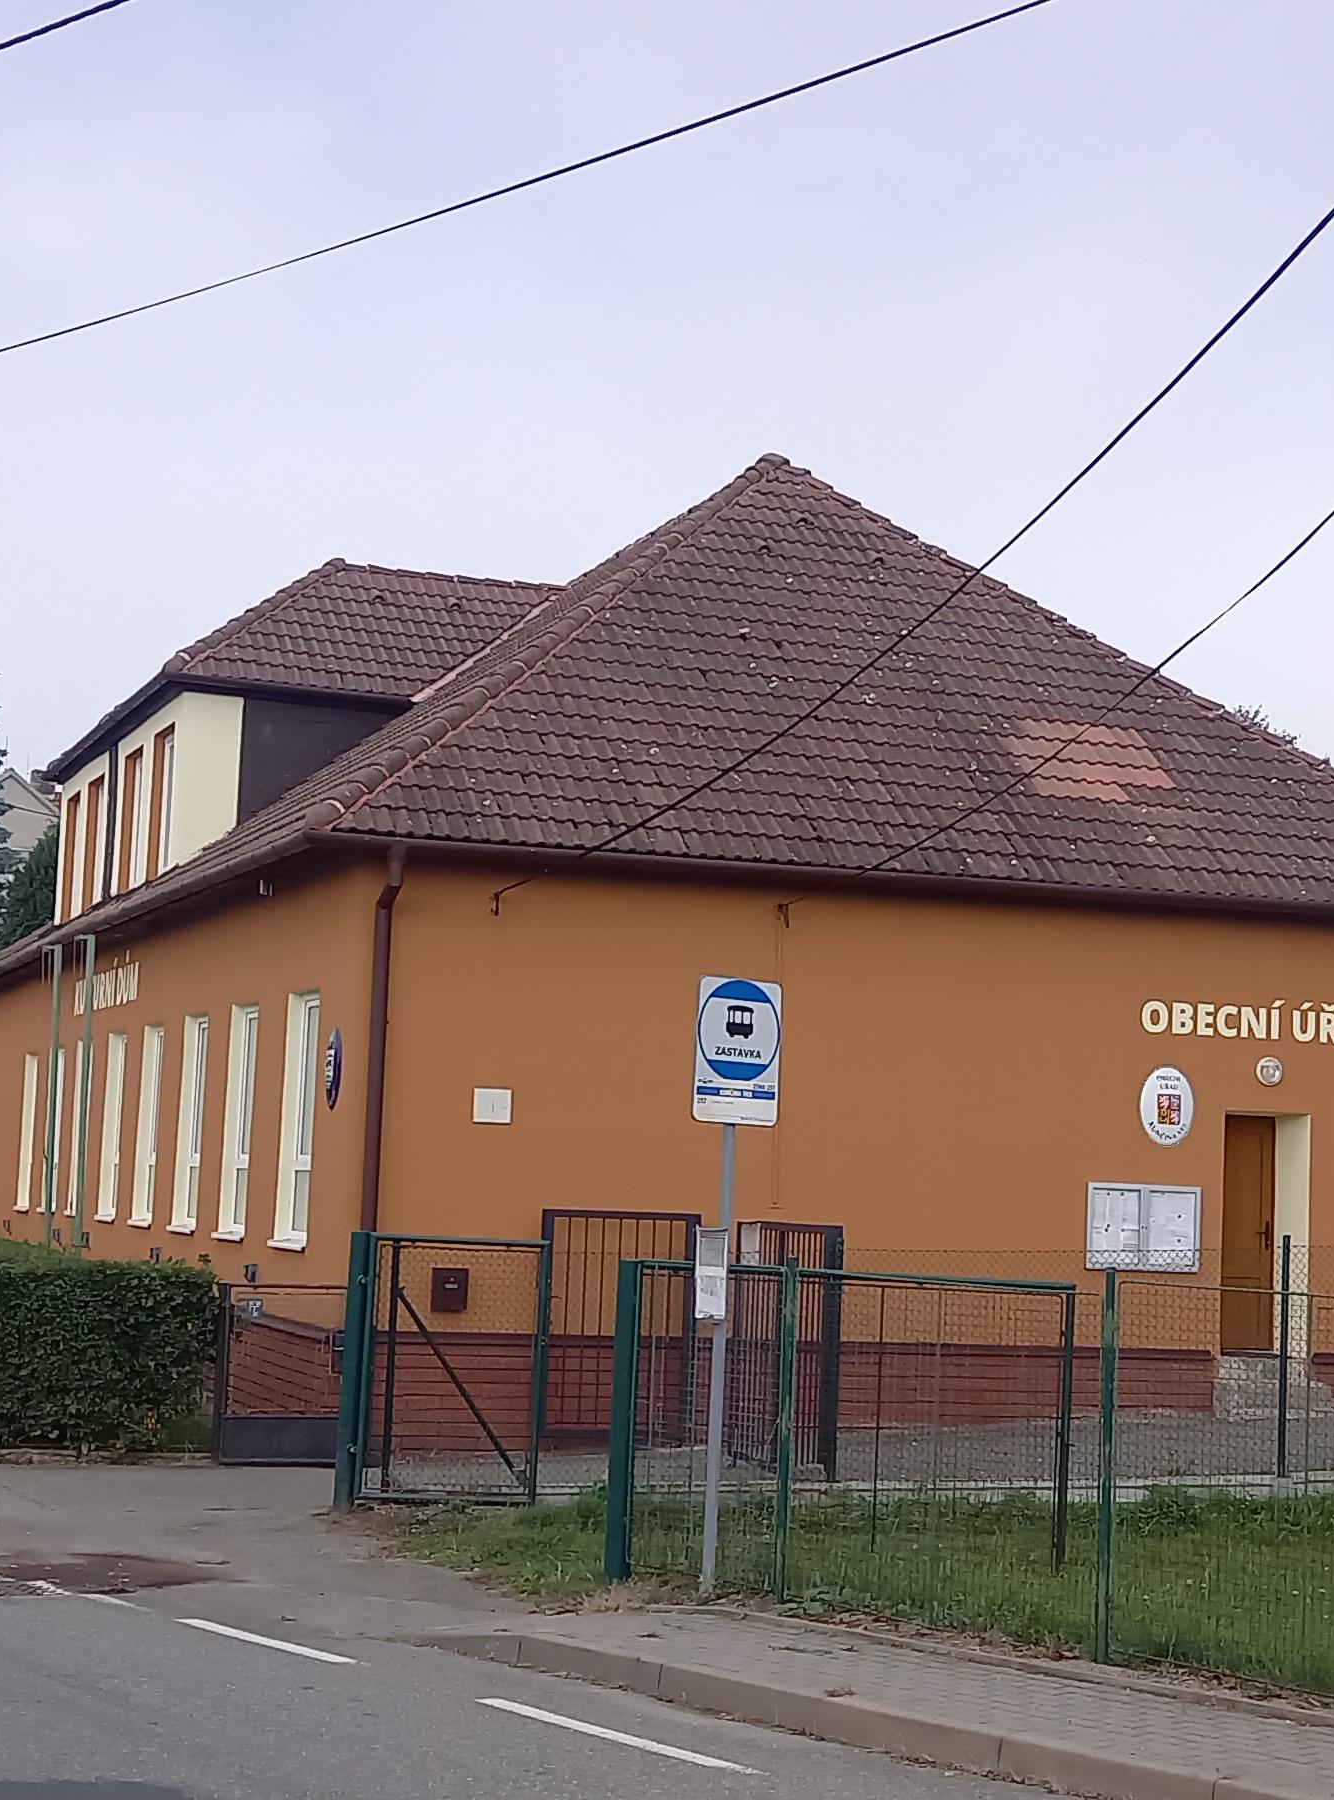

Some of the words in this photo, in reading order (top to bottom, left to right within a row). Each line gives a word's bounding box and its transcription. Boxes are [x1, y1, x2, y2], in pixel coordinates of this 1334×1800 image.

[73, 957, 118, 1017] KUURNÍ
[1140, 1000, 1286, 1040] OBECNÍ
[714, 1045, 761, 1060] ZASTÁVKA
